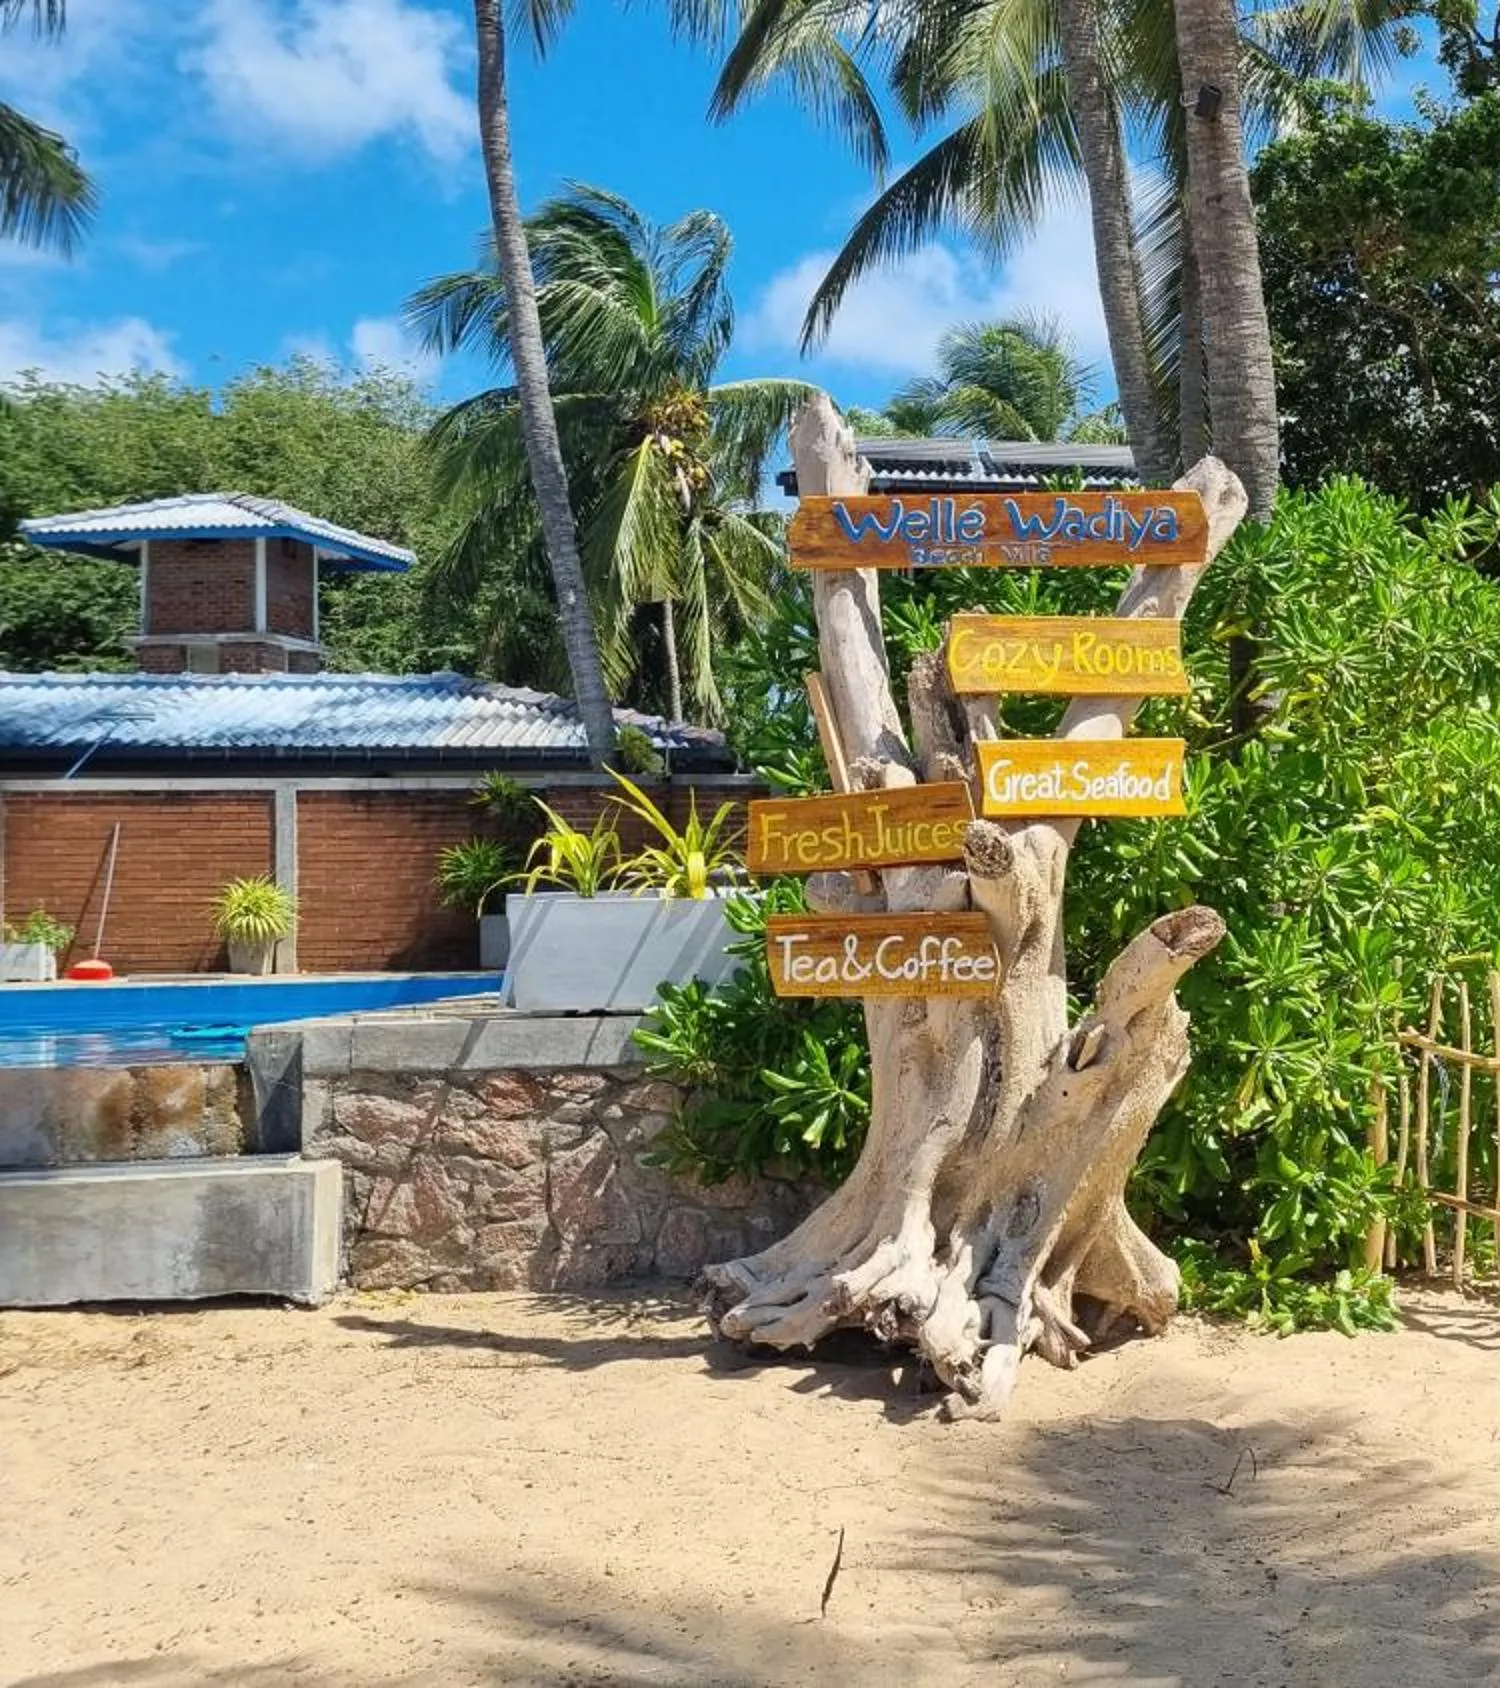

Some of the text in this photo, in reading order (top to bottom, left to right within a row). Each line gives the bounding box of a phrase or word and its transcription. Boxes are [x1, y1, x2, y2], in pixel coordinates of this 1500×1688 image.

[1003, 496, 1178, 551] Wadiya
[950, 629, 1182, 688] Cozy Rooms
[988, 759, 1172, 803] Great Seafood
[760, 804, 968, 863] Fresh Juices
